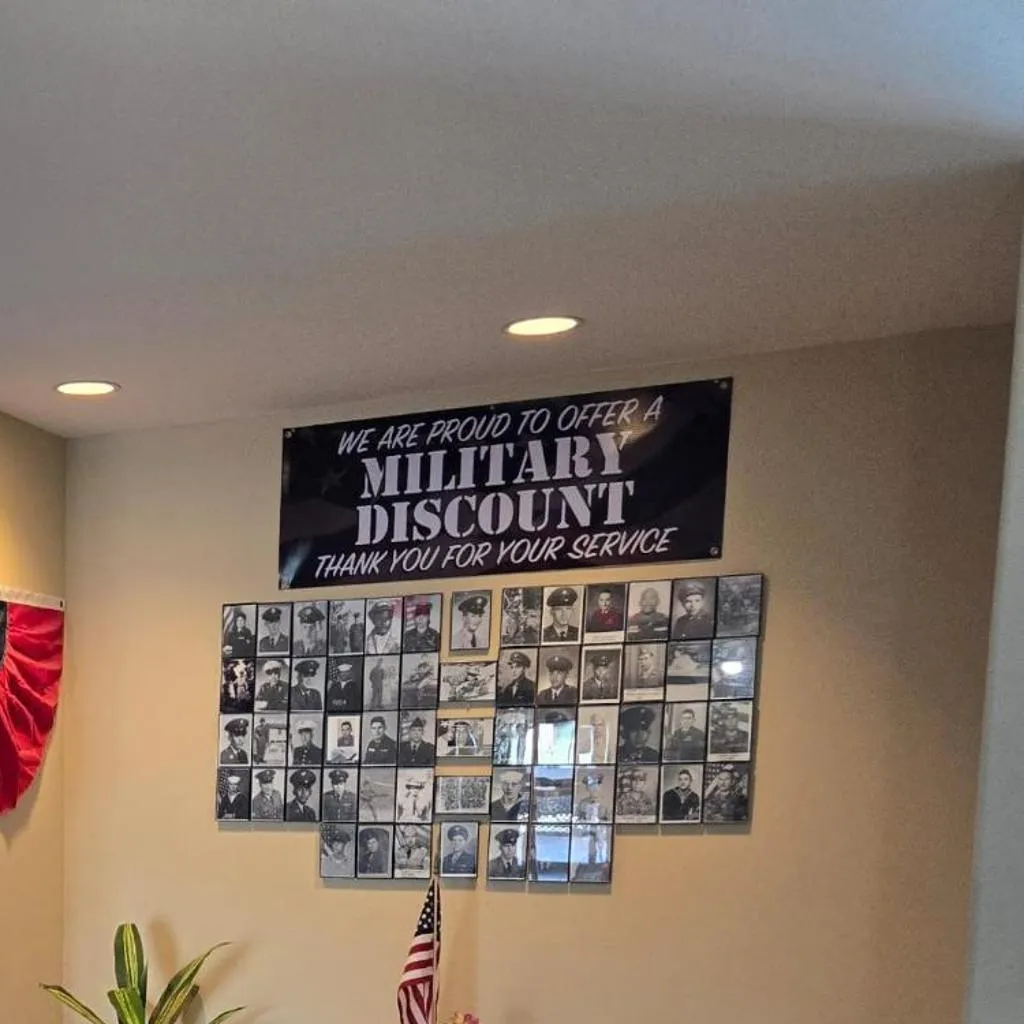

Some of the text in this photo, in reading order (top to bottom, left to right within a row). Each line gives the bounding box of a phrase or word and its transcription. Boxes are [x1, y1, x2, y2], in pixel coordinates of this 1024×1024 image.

[337, 395, 664, 455] WE ARE PROUD TO OFFER A
[360, 430, 634, 499] MILITARY
[354, 480, 635, 546] DISCOUNT
[314, 527, 679, 579] THANK YOU FOR YOUR SERVICE
